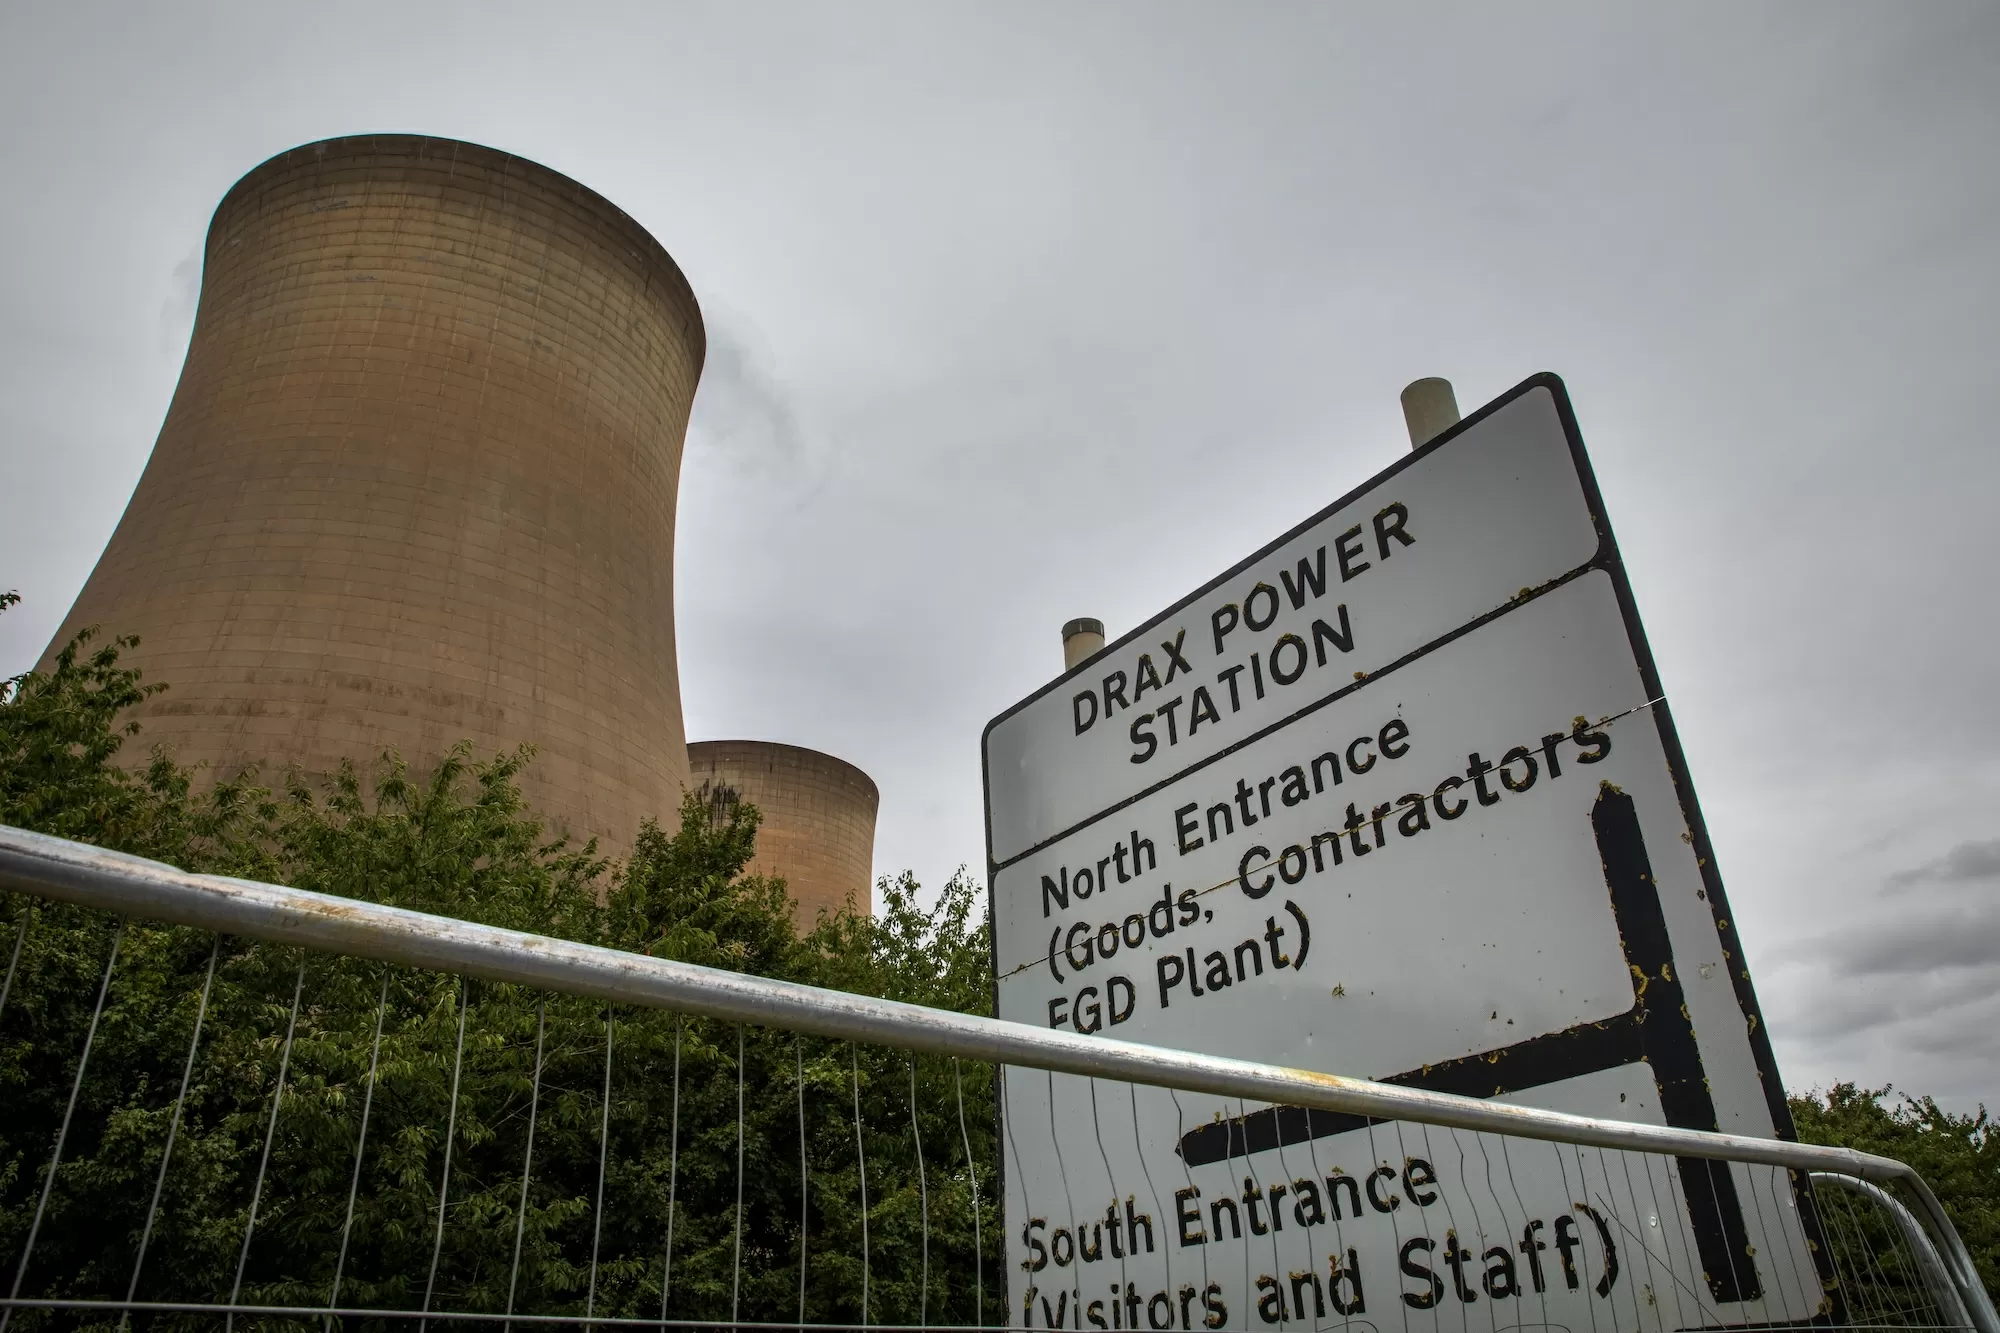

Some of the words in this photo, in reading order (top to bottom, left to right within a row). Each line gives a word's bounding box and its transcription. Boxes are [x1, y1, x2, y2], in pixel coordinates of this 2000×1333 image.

[1073, 629, 1192, 735] DRAX
[1212, 502, 1416, 655] POWER
[1129, 604, 1355, 764] STATION
[1041, 831, 1156, 918] North
[1174, 718, 1411, 856] Entrance
[1049, 884, 1213, 984] (Goods,
[1239, 717, 1612, 899] Contractors
[1048, 976, 1135, 1035] FGD
[1157, 901, 1310, 1009] Plant)
[1022, 1195, 1154, 1273] South
[1175, 1157, 1437, 1247] Entrance
[1255, 1248, 1366, 1323] and
[1400, 1203, 1619, 1309] Staff)
